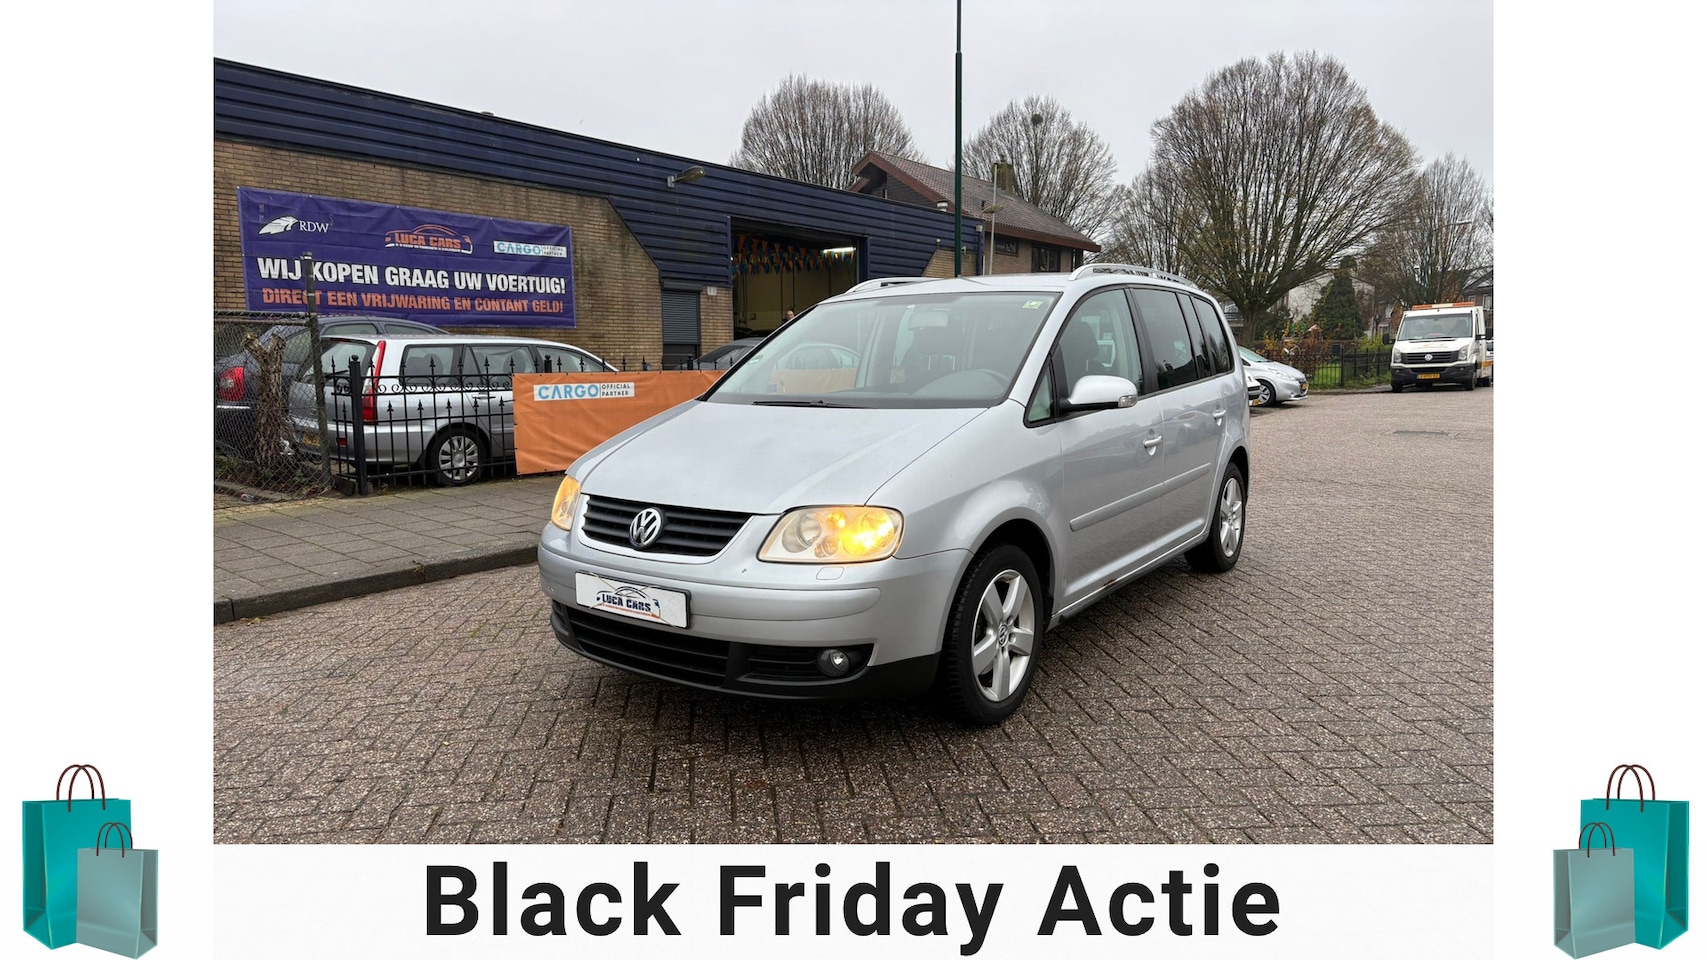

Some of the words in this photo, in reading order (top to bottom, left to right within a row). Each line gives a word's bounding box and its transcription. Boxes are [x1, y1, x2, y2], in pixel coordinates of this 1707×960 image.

[300, 221, 329, 233] RDW
[394, 232, 426, 246] LUCA
[429, 236, 461, 249] CARS
[496, 242, 542, 255] CARGO
[257, 257, 302, 280] WIJ
[312, 261, 379, 285] KOPEN
[385, 266, 449, 289] GRAAG
[454, 271, 482, 291] UW
[486, 273, 566, 294] VOERTUIG!
[327, 290, 358, 306] EEN
[361, 292, 450, 309] VRIJWARING
[454, 297, 471, 311] EN
[475, 298, 529, 312] CONTANT
[532, 300, 563, 313] GELD!
[538, 384, 599, 400] CARGO
[602, 593, 624, 607] LUCA
[626, 598, 651, 612] CARS
